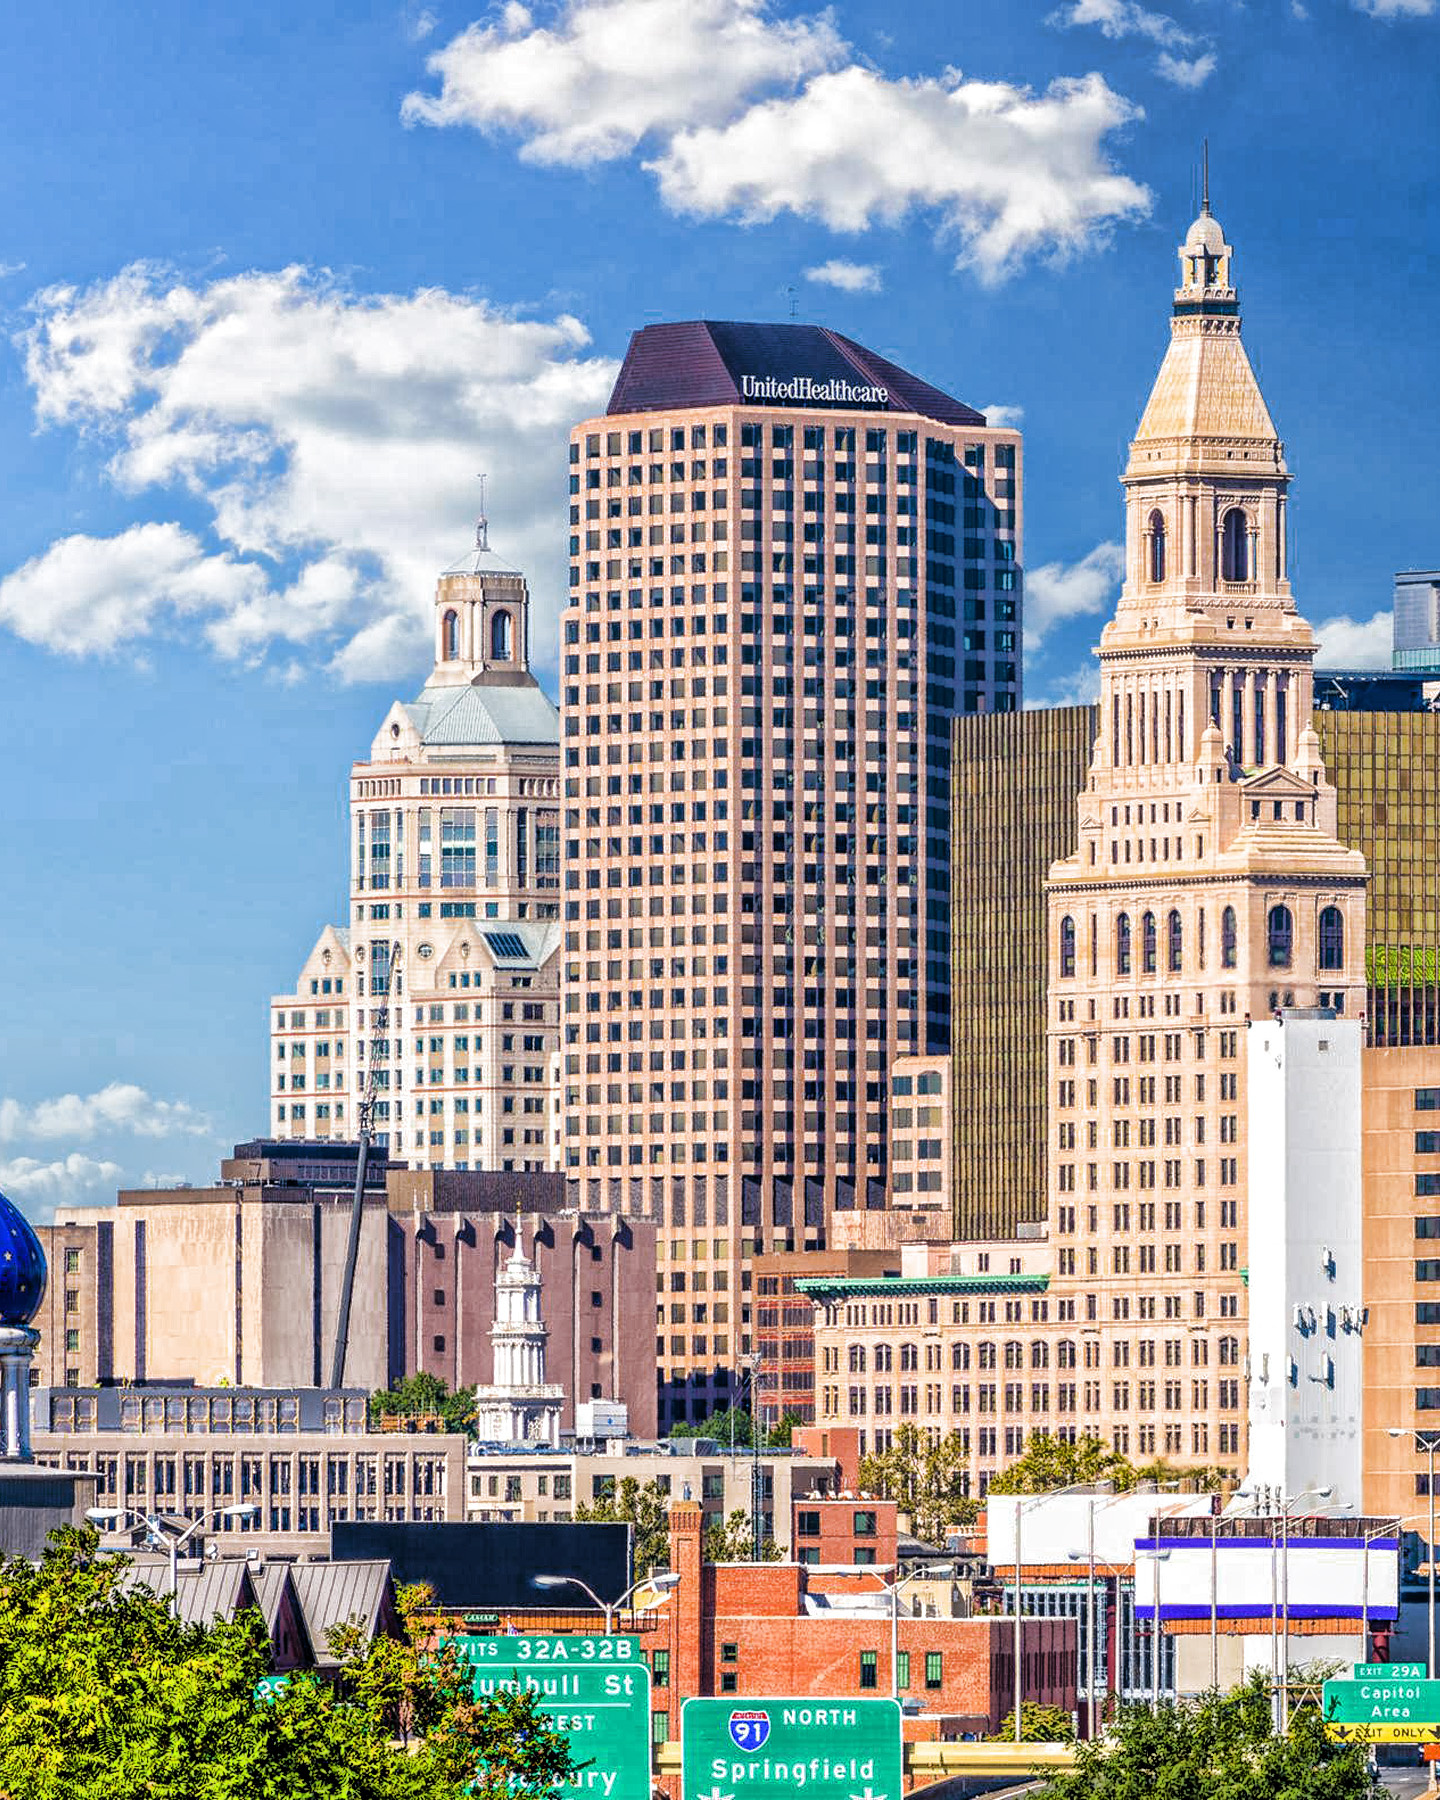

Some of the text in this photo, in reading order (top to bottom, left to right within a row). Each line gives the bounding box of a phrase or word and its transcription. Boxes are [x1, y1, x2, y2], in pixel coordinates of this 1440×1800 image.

[741, 375, 888, 402] UnitedHealthcare
[447, 1640, 632, 1660] XITS 32A-32B
[1360, 1666, 1420, 1677] EXIT 29A
[472, 1674, 634, 1696] umbull St
[1361, 1686, 1421, 1701] Capitol
[783, 1709, 856, 1725] NORTH
[1372, 1705, 1410, 1717] Area
[735, 1722, 760, 1741] 91
[1393, 1728, 1425, 1737] ONLY
[711, 1758, 874, 1787] Springfield
